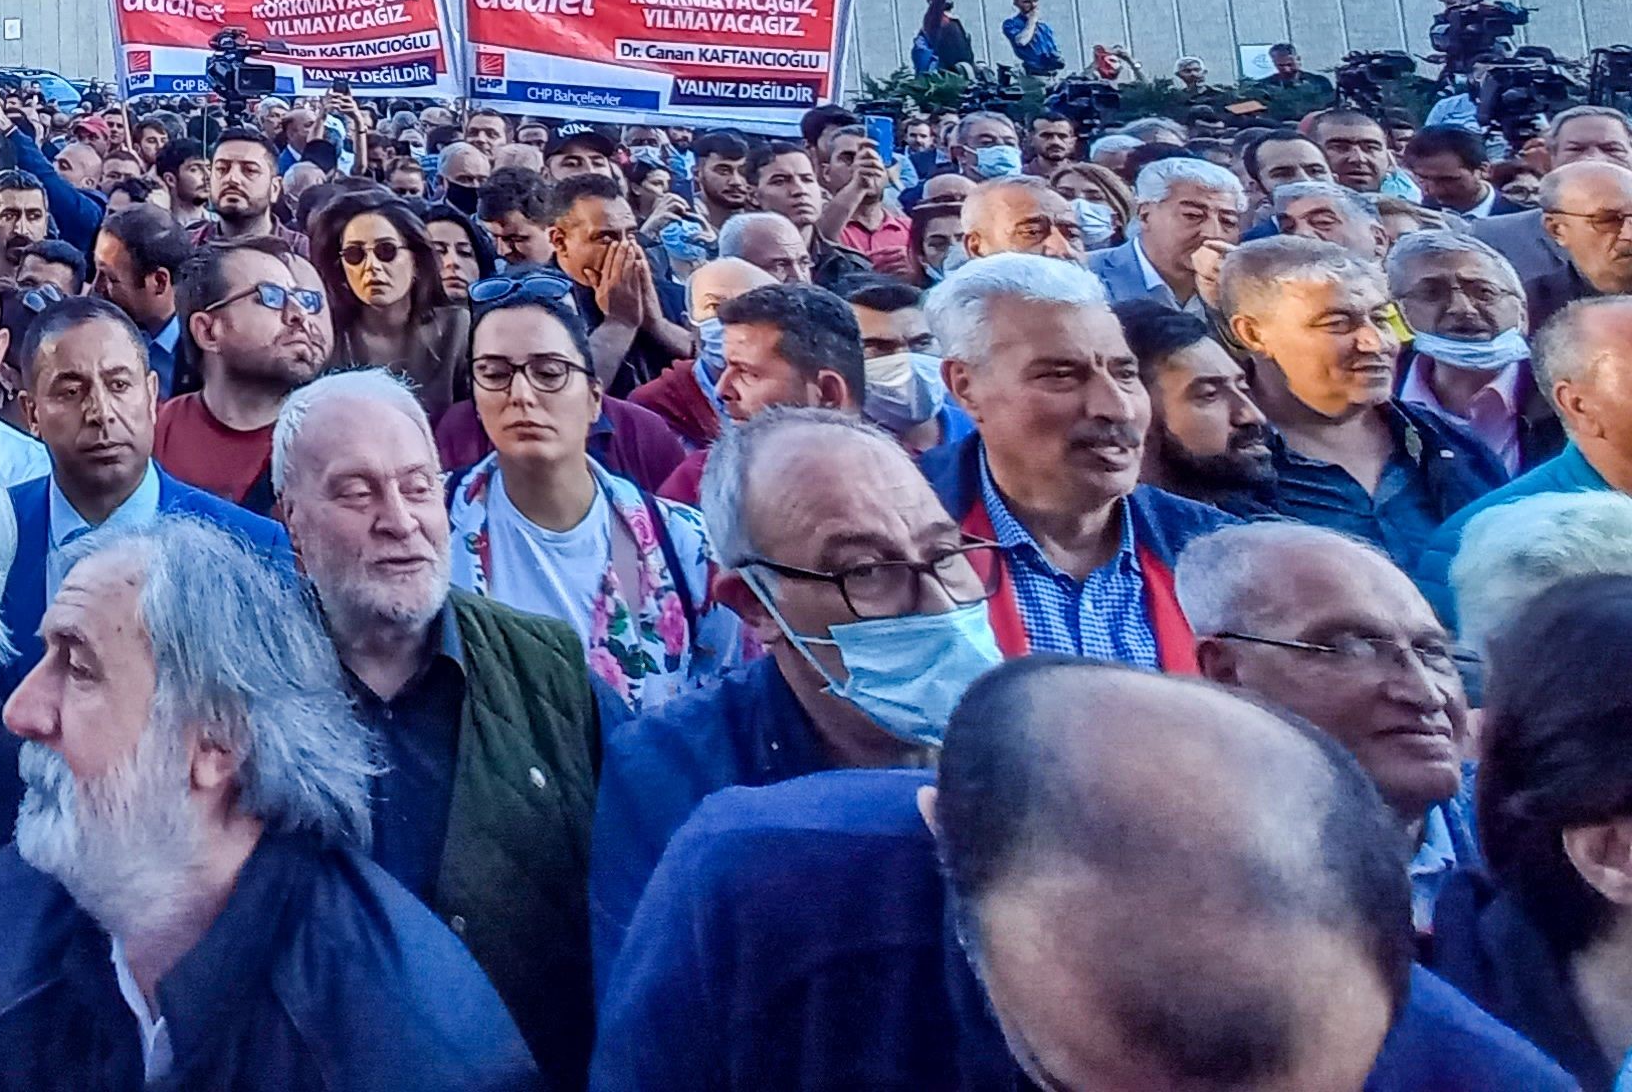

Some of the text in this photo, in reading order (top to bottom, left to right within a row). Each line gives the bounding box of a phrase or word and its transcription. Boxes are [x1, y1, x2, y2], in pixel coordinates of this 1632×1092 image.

[642, 7, 806, 37] YILMAYACAĞIZ.
[621, 43, 820, 69] Dr. Canan KAFTANCIOĞLU
[360, 63, 432, 84] DEĞİLDİR
[477, 77, 502, 88] CHP
[172, 79, 196, 91] CHP
[677, 79, 813, 103] YALNIZ DEĞİLDİR
[527, 87, 622, 106] CHP Bahçelievler
